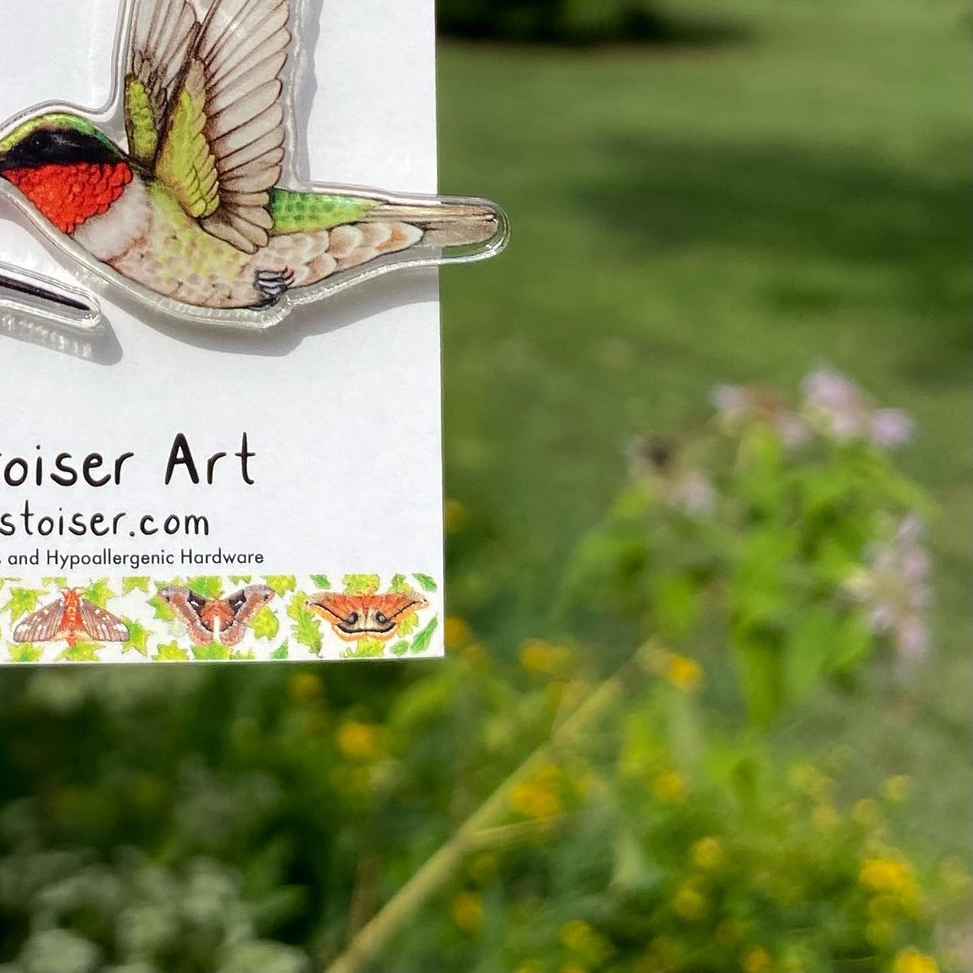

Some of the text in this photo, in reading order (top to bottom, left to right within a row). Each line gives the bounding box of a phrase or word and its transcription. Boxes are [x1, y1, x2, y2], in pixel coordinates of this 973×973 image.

[164, 431, 256, 485] Art
[8, 548, 39, 565] and
[46, 548, 175, 570] Hypoallergenic
[180, 547, 265, 565] Hardware
